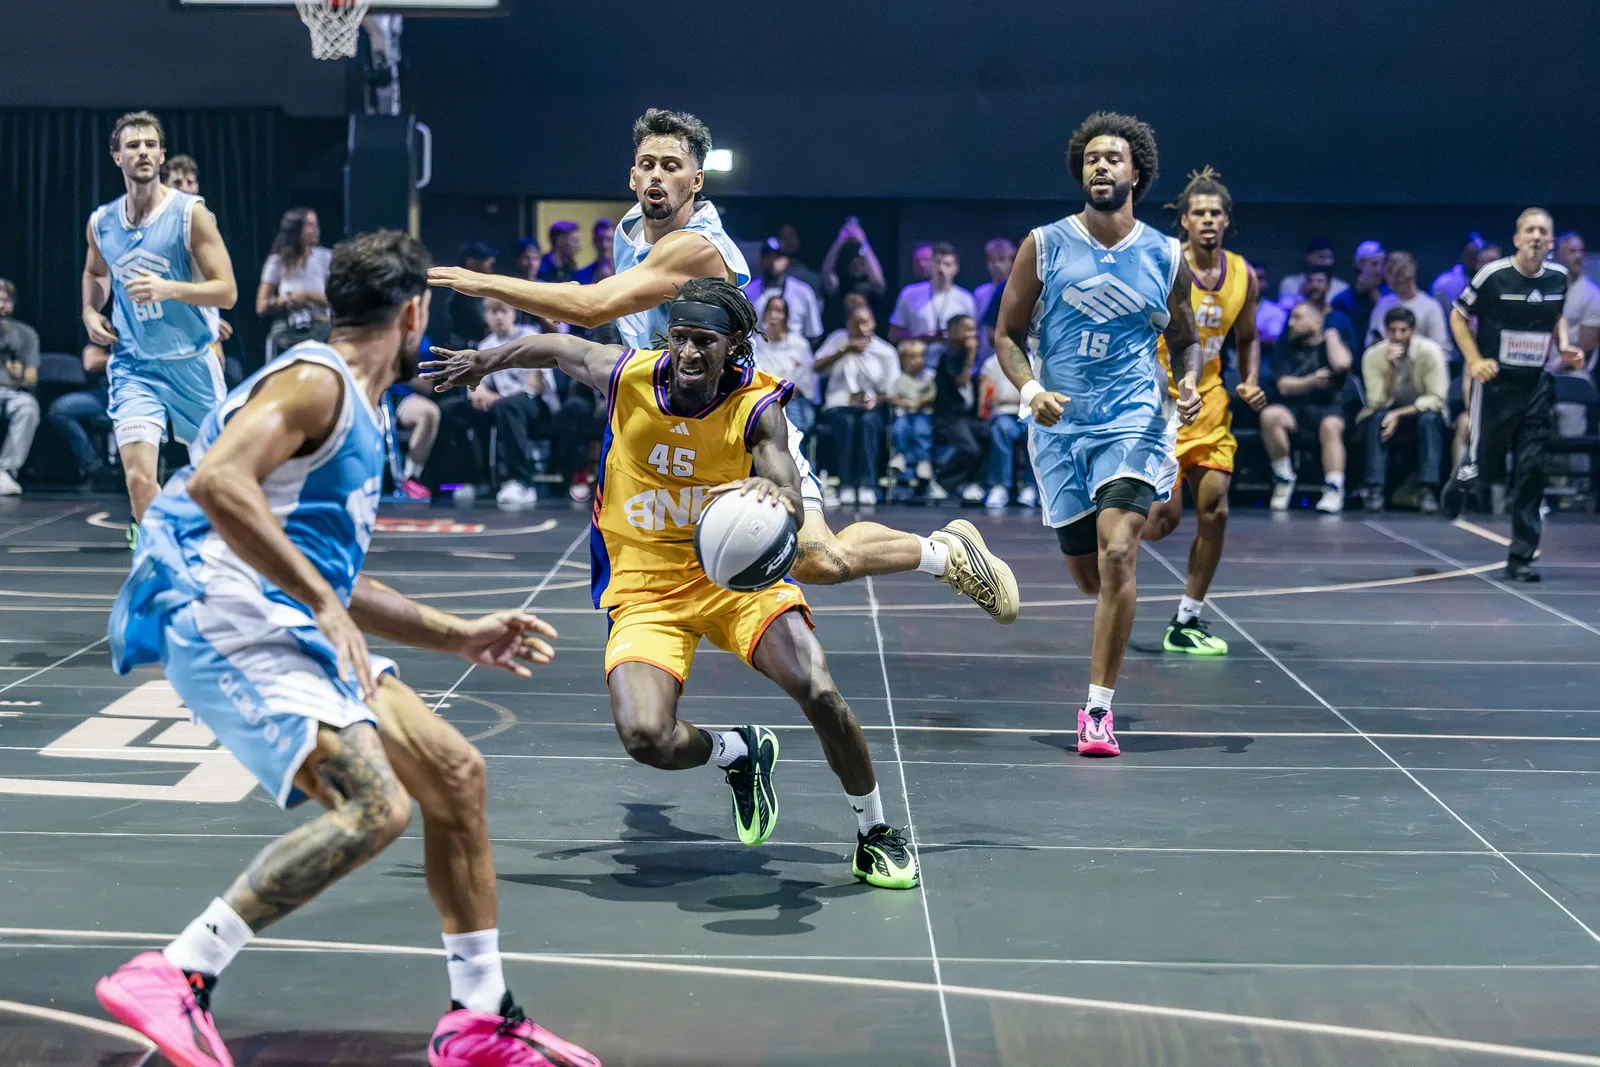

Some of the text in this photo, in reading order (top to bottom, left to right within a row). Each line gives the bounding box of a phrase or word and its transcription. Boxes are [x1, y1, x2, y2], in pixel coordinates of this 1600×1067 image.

[1195, 304, 1223, 329] 42
[1077, 329, 1110, 358] 15
[647, 442, 697, 478] 45
